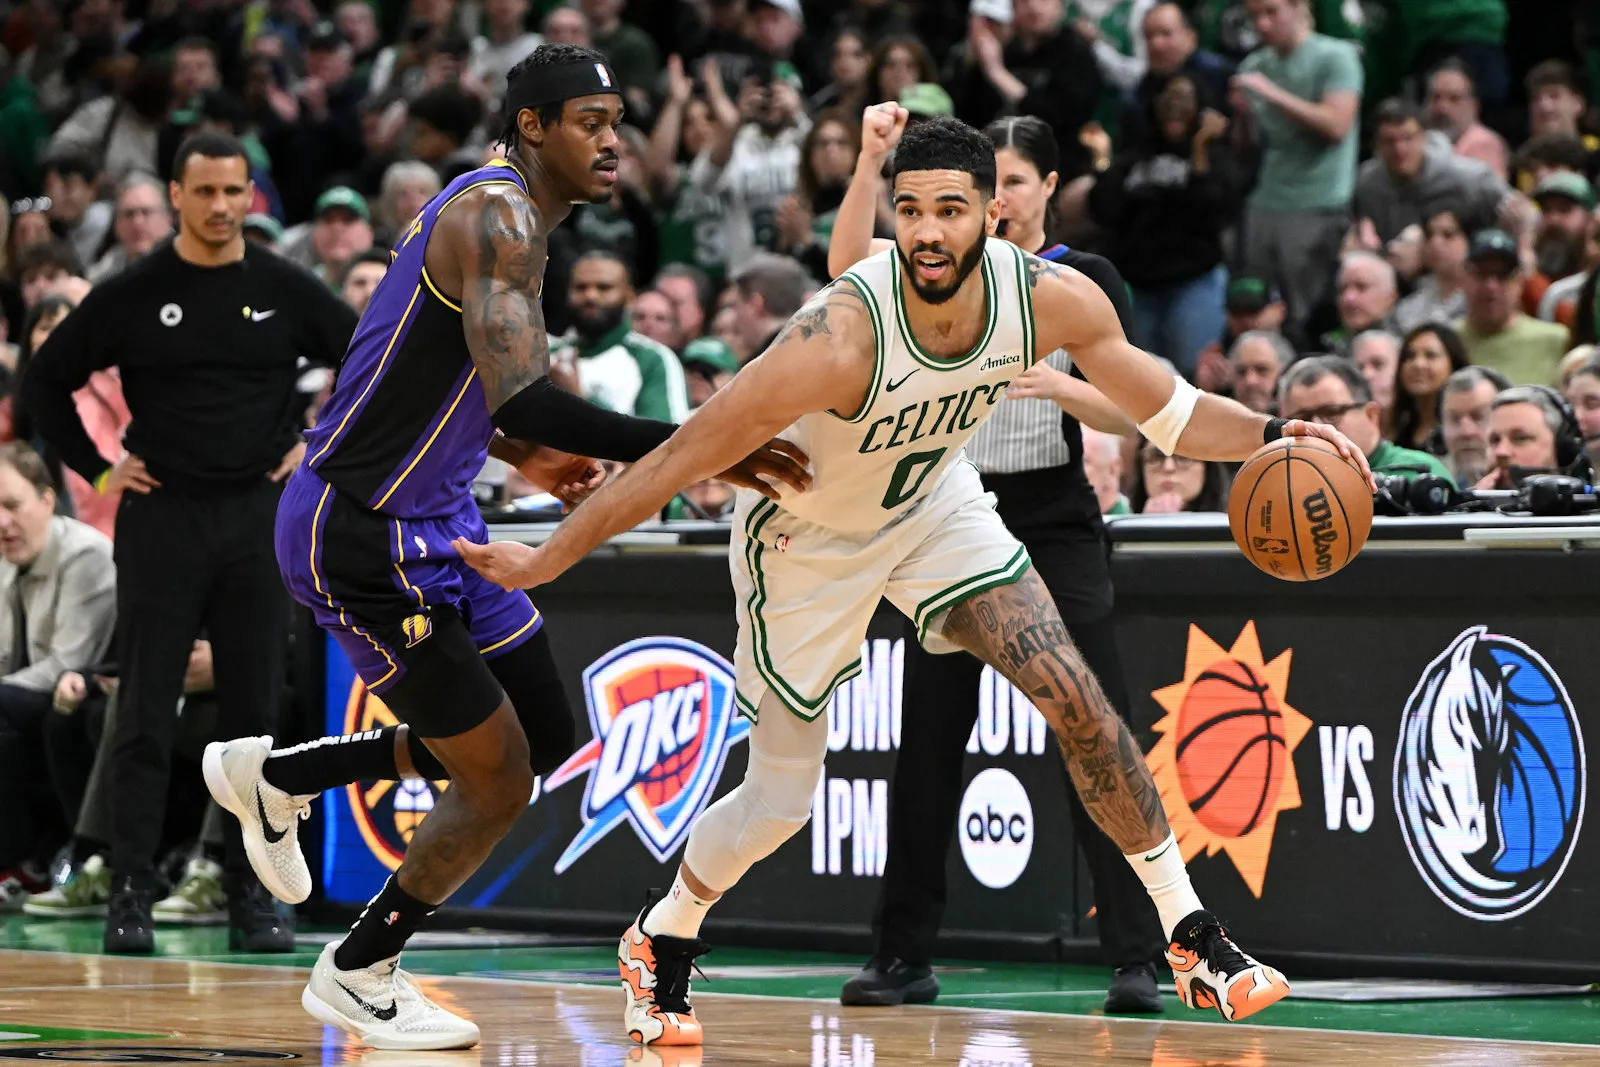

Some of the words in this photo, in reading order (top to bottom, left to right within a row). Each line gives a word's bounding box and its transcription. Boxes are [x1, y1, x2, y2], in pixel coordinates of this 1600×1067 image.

[980, 354, 1020, 371] Amica
[881, 446, 948, 510] 0
[1302, 487, 1338, 575] Wilson
[590, 680, 706, 811] OKC
[1318, 724, 1375, 833] VS
[811, 763, 888, 877] 1PM
[966, 804, 1026, 844] abc
